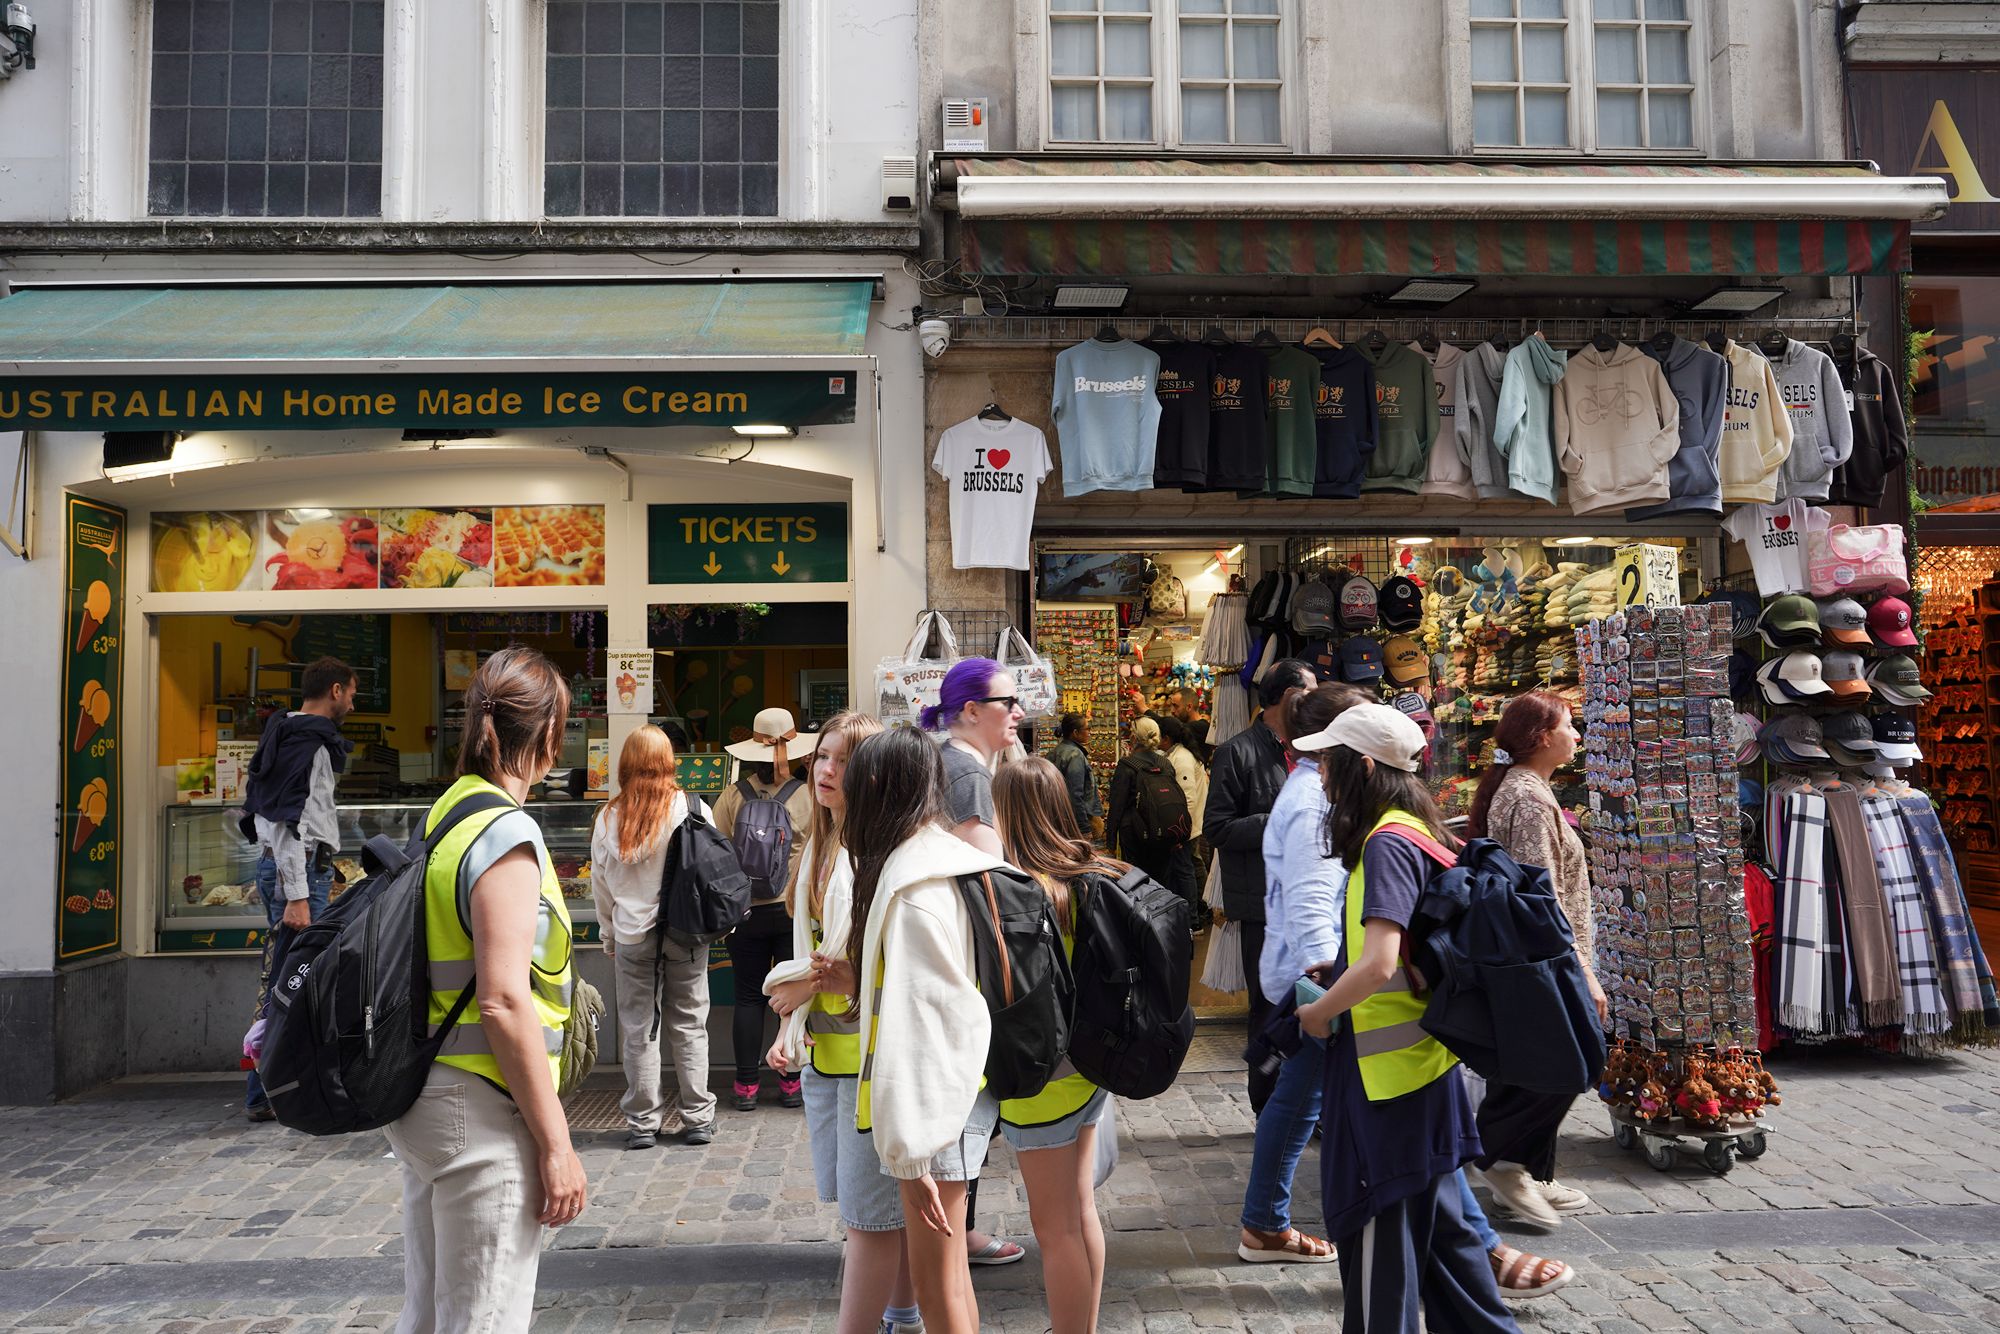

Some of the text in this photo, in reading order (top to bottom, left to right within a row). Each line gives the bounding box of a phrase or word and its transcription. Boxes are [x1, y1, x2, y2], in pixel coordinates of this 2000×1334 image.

[1909, 99, 2000, 203] A
[1074, 374, 1147, 393] Brussels
[283, 389, 397, 417] Home
[418, 388, 522, 416] Made
[544, 386, 600, 414] Ice
[622, 385, 748, 415] Cream
[974, 448, 986, 469] I
[963, 471, 1024, 494] BRUSSELS
[679, 517, 818, 543] TICKETS
[1765, 516, 1775, 532] I
[1619, 547, 1641, 557] MAGNETS
[621, 652, 653, 660] strawberry
